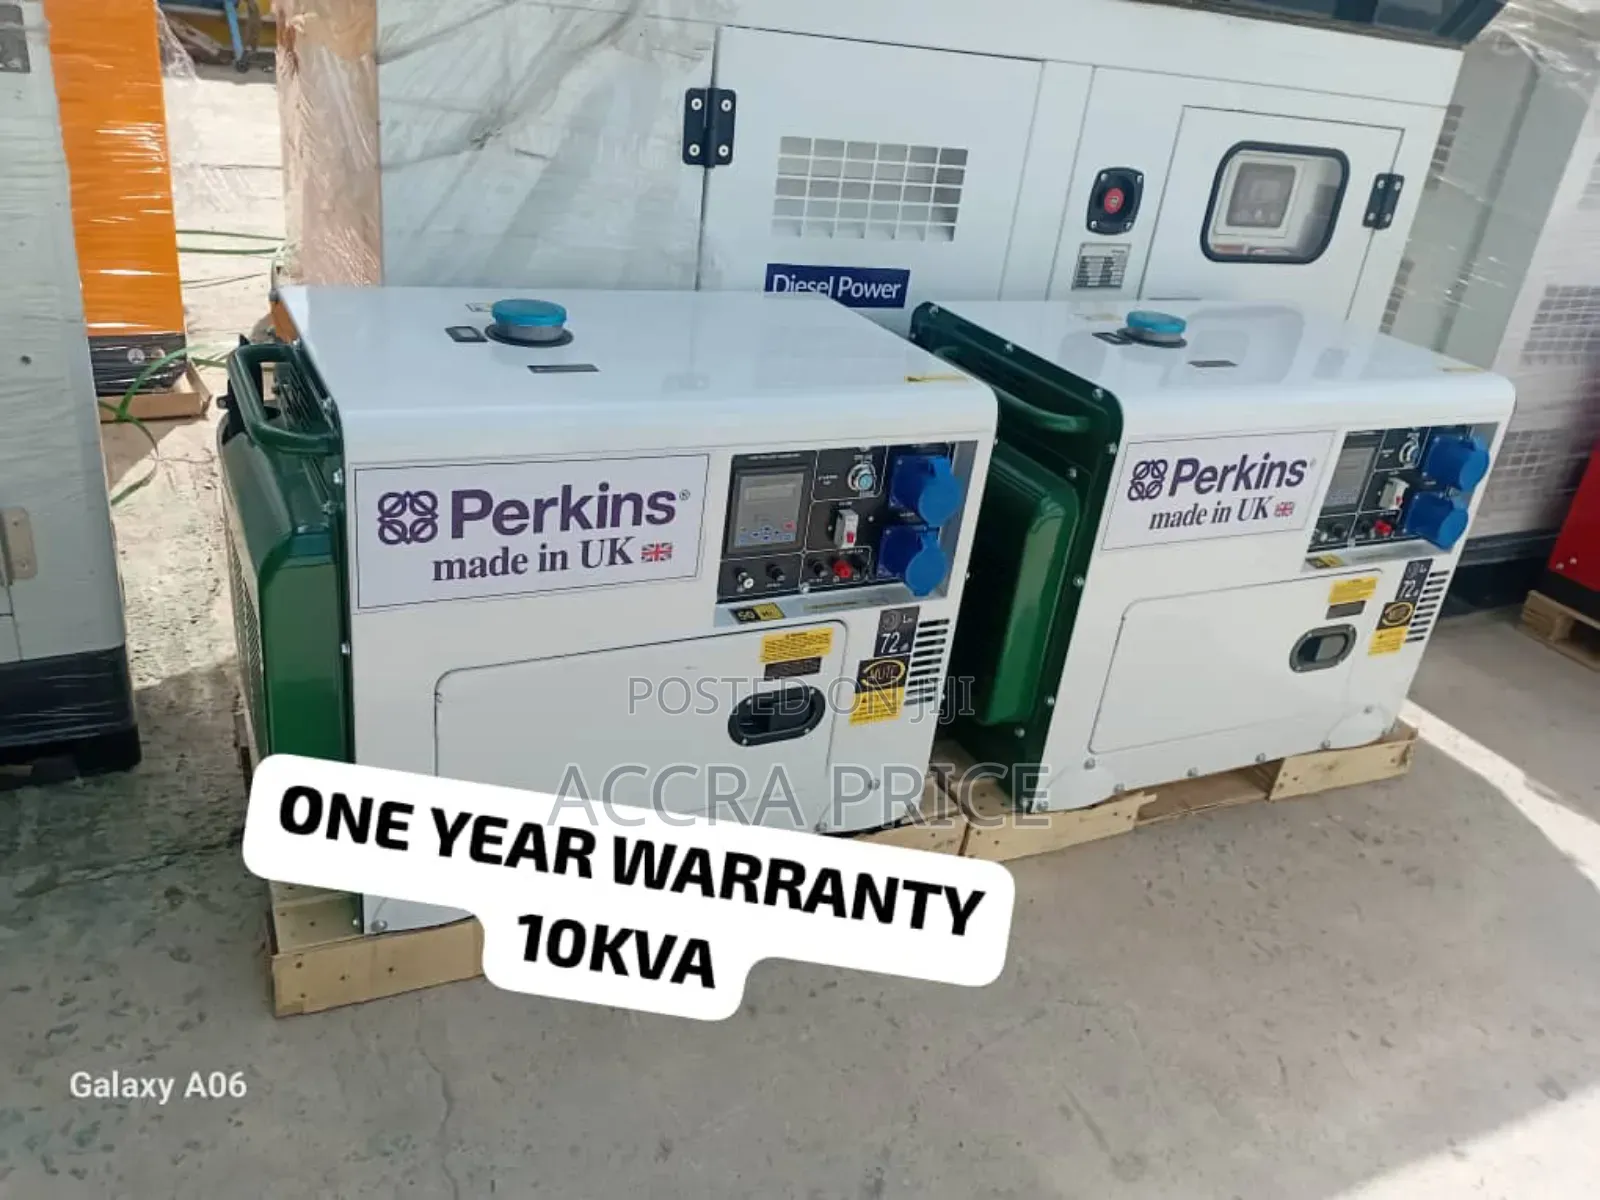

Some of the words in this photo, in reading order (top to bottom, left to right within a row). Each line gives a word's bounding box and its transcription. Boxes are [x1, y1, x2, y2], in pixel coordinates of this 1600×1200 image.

[773, 274, 834, 298] Diesel
[837, 276, 901, 299] Power
[1168, 452, 1308, 497] Perkins
[451, 481, 677, 540] Perkins
[1148, 503, 1208, 531] made
[1211, 499, 1231, 524] in
[1237, 496, 1273, 521] UK
[433, 547, 528, 581] made
[538, 543, 569, 573] in
[579, 536, 636, 569] UK
[1399, 580, 1416, 599] 72
[880, 631, 901, 654] 72
